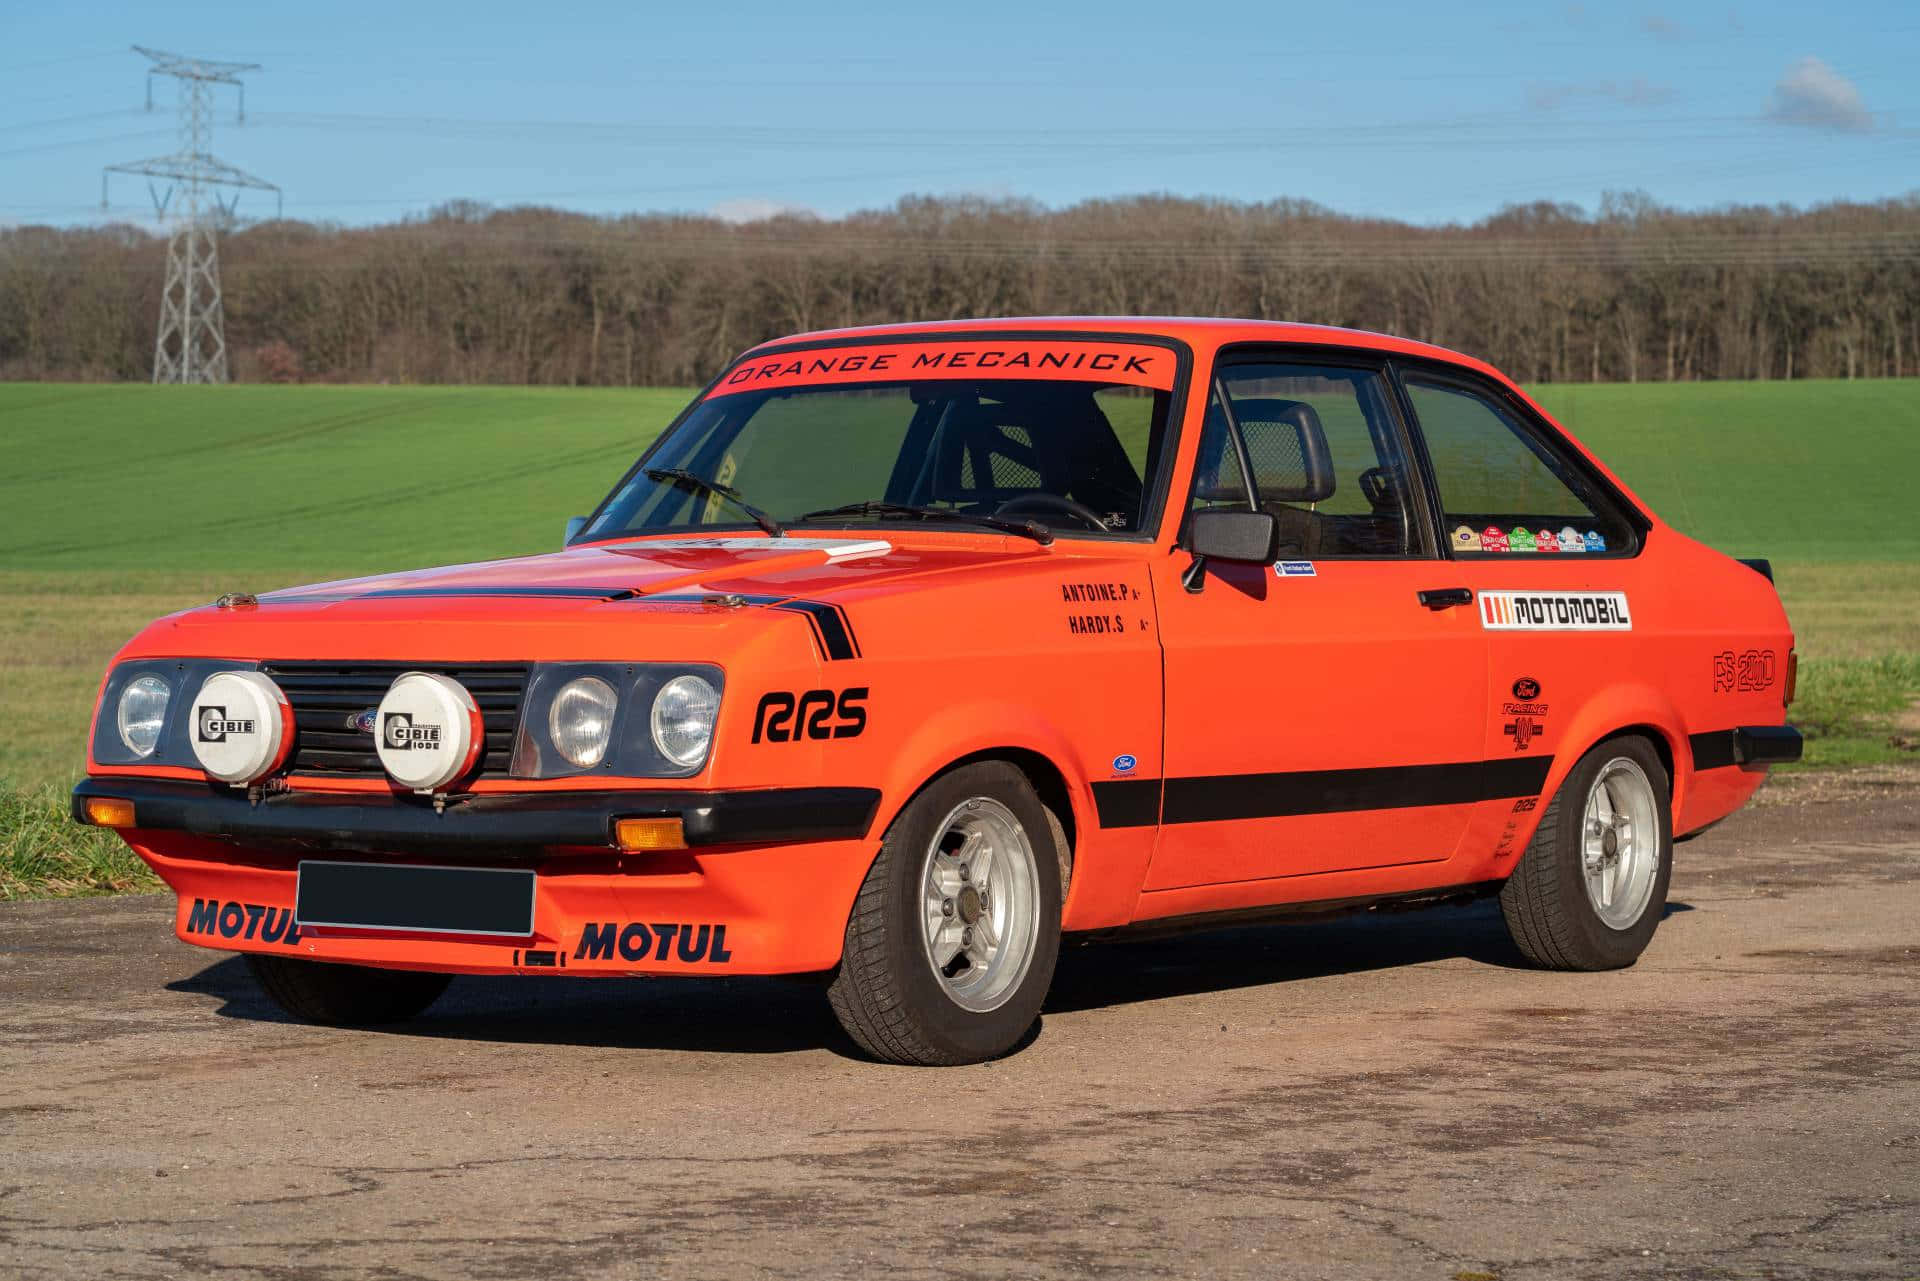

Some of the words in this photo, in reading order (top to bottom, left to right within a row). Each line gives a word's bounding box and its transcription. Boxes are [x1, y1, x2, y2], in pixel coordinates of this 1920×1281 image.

[728, 354, 897, 385] ORANGE
[912, 351, 1154, 375] MECANICK
[1713, 650, 1736, 693] RS
[750, 687, 870, 745] RRS
[1502, 702, 1548, 716] RACING
[186, 897, 303, 945] MOTUL
[573, 922, 733, 963] MOTUL
